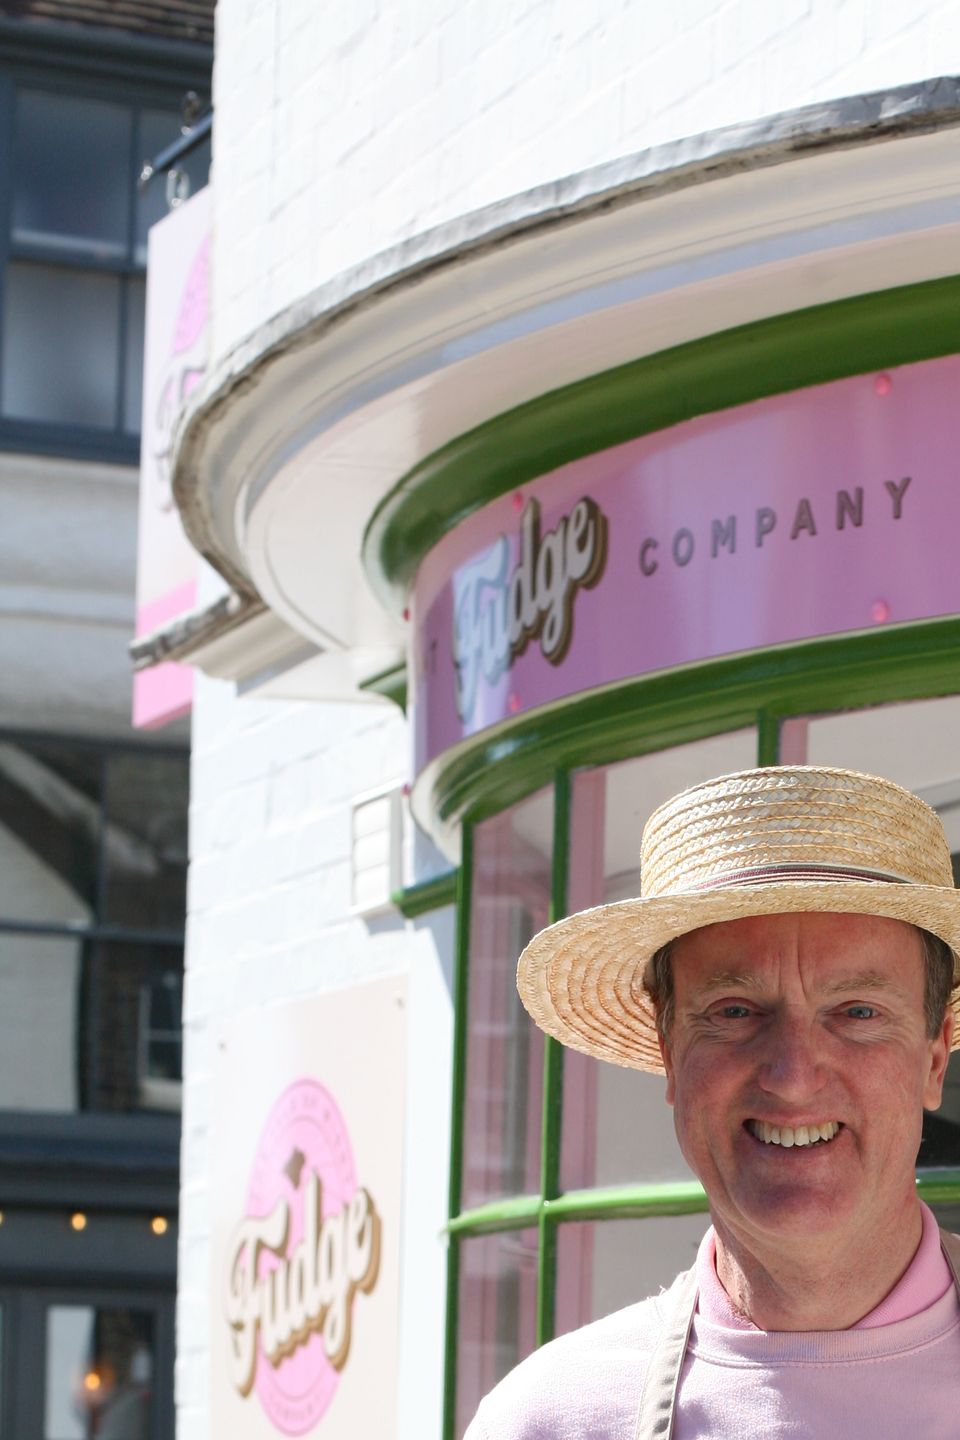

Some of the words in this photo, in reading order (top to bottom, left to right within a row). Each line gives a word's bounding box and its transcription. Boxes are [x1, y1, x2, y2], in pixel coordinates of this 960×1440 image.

[453, 496, 608, 723] Fudge
[638, 475, 912, 576] COMPANY
[225, 1169, 383, 1398] Fudge
